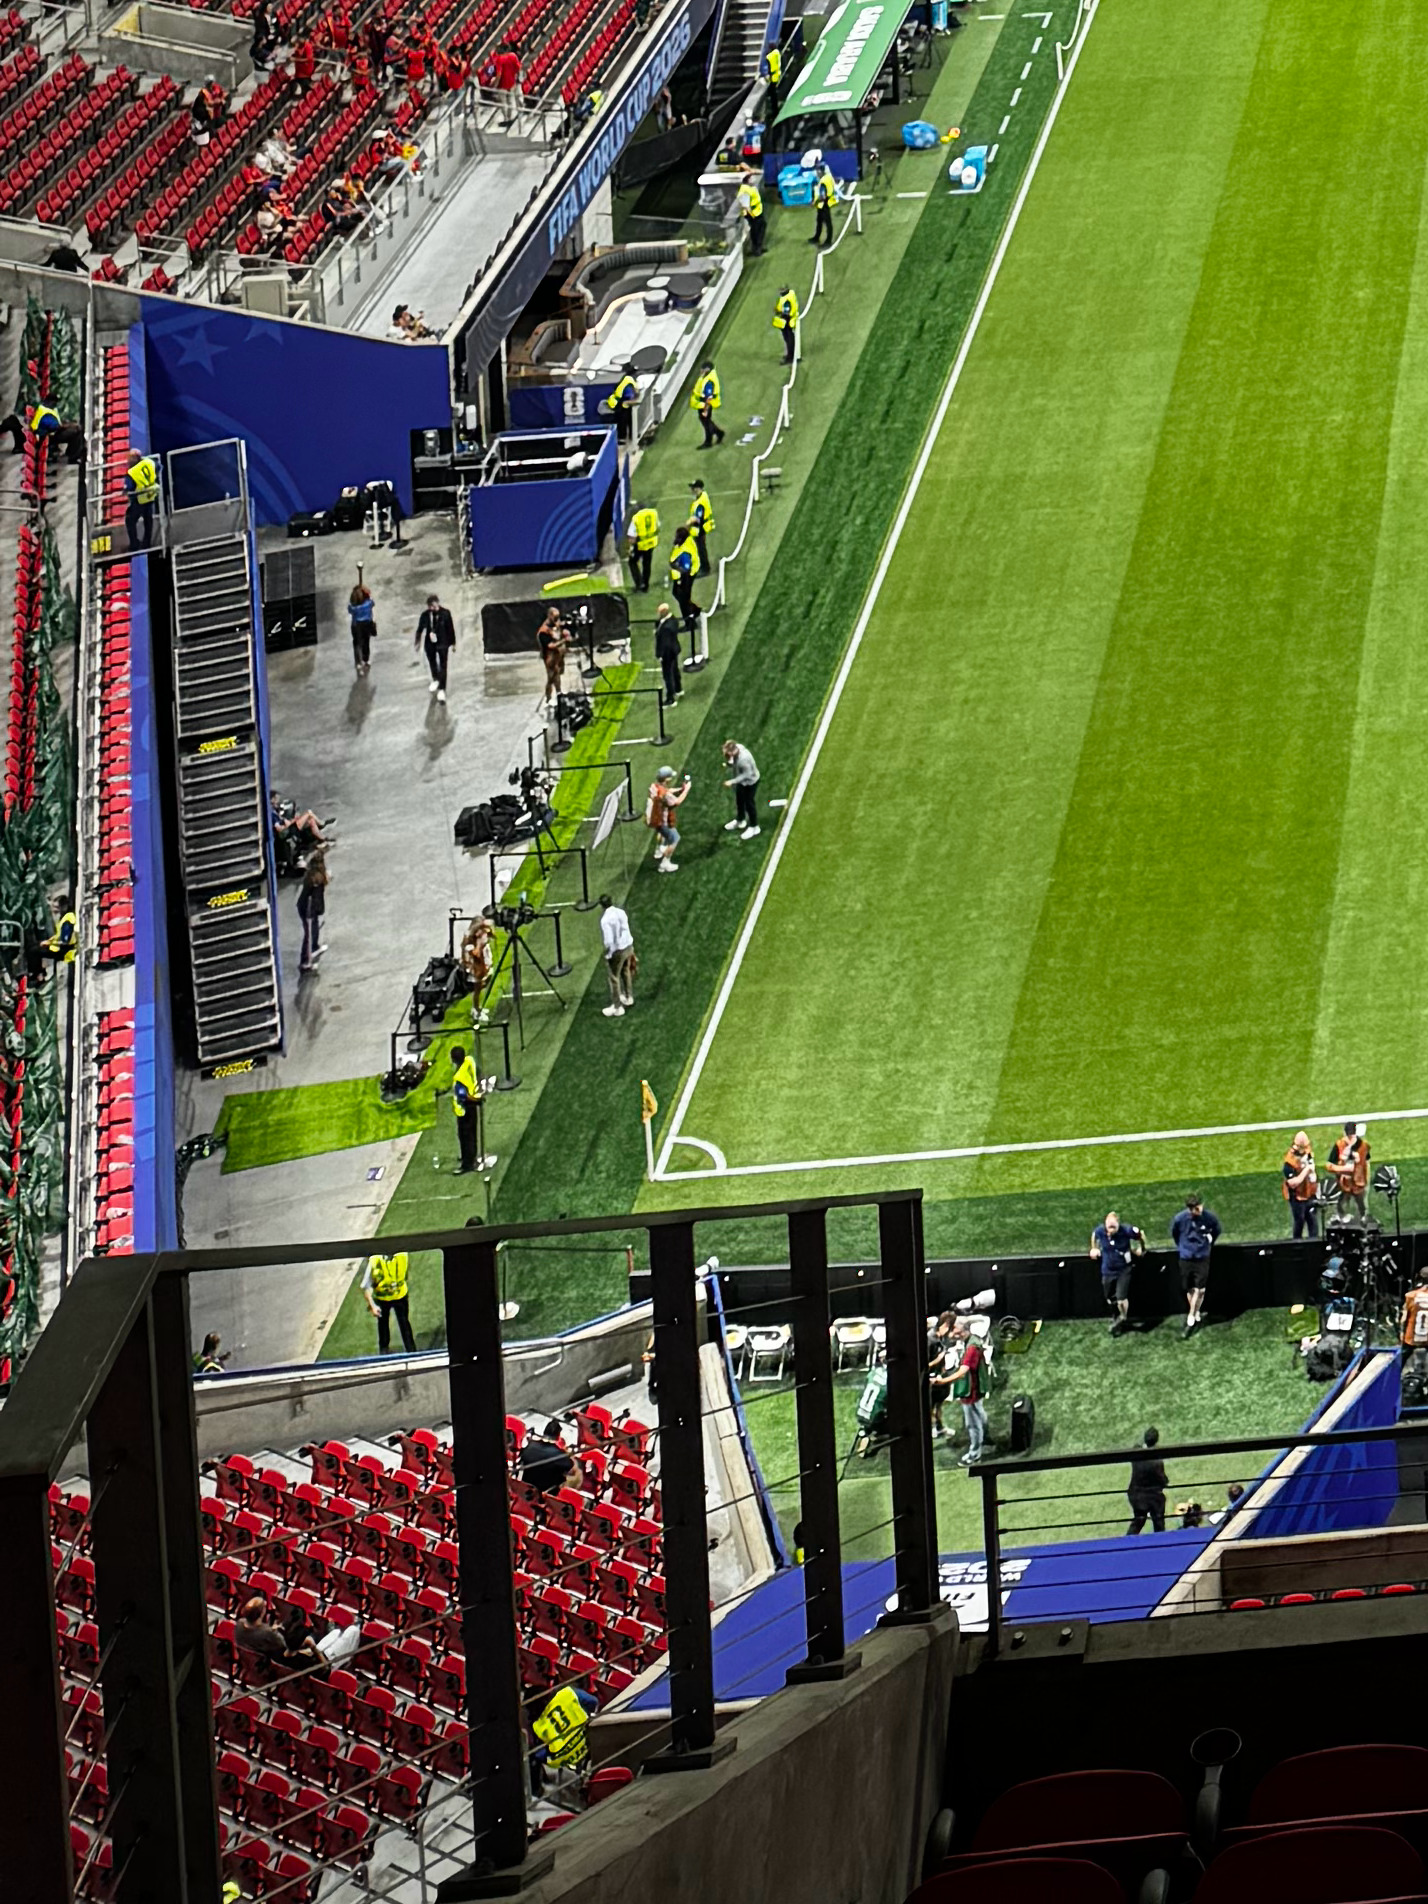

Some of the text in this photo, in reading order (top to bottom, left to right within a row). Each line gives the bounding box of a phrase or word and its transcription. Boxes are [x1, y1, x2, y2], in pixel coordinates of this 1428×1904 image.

[548, 12, 691, 257] FIFA WORLD CUP 2026
